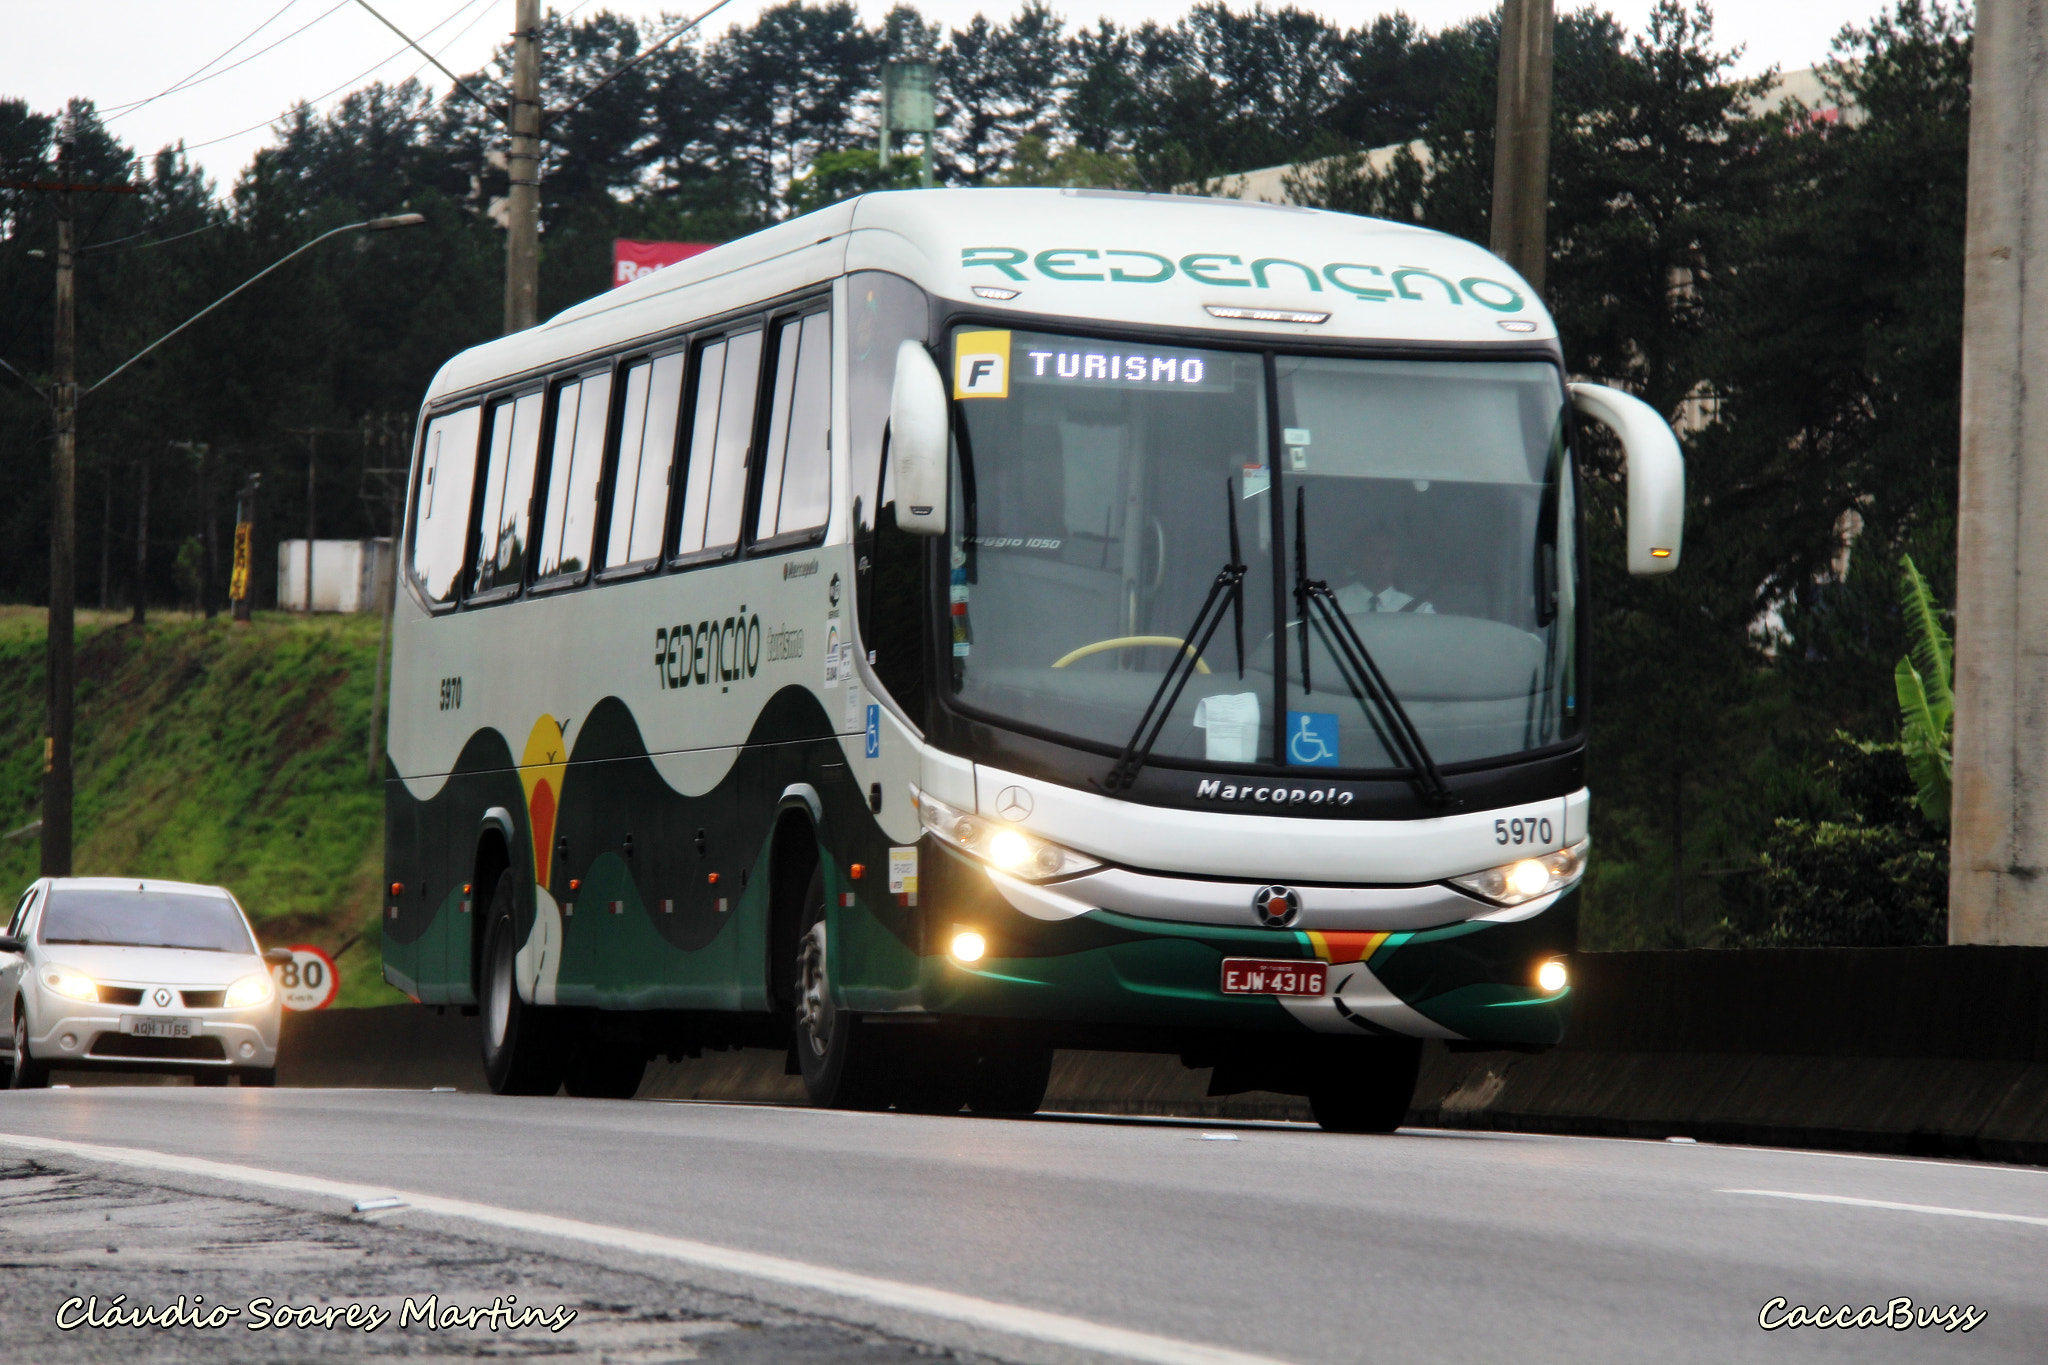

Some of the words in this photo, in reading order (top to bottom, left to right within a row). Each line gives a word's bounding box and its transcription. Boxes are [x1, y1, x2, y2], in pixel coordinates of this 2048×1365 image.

[617, 260, 665, 281] Re
[961, 246, 1525, 313] REDENÇÃO
[968, 360, 995, 388] F
[1029, 351, 1204, 384] TURISMO
[1025, 536, 1062, 549] 1050
[655, 604, 760, 693] REDENÇÃO
[440, 676, 462, 711] 5970
[1196, 779, 1354, 807] Marcopolo
[1494, 817, 1553, 846] 5970
[280, 960, 323, 990] 80
